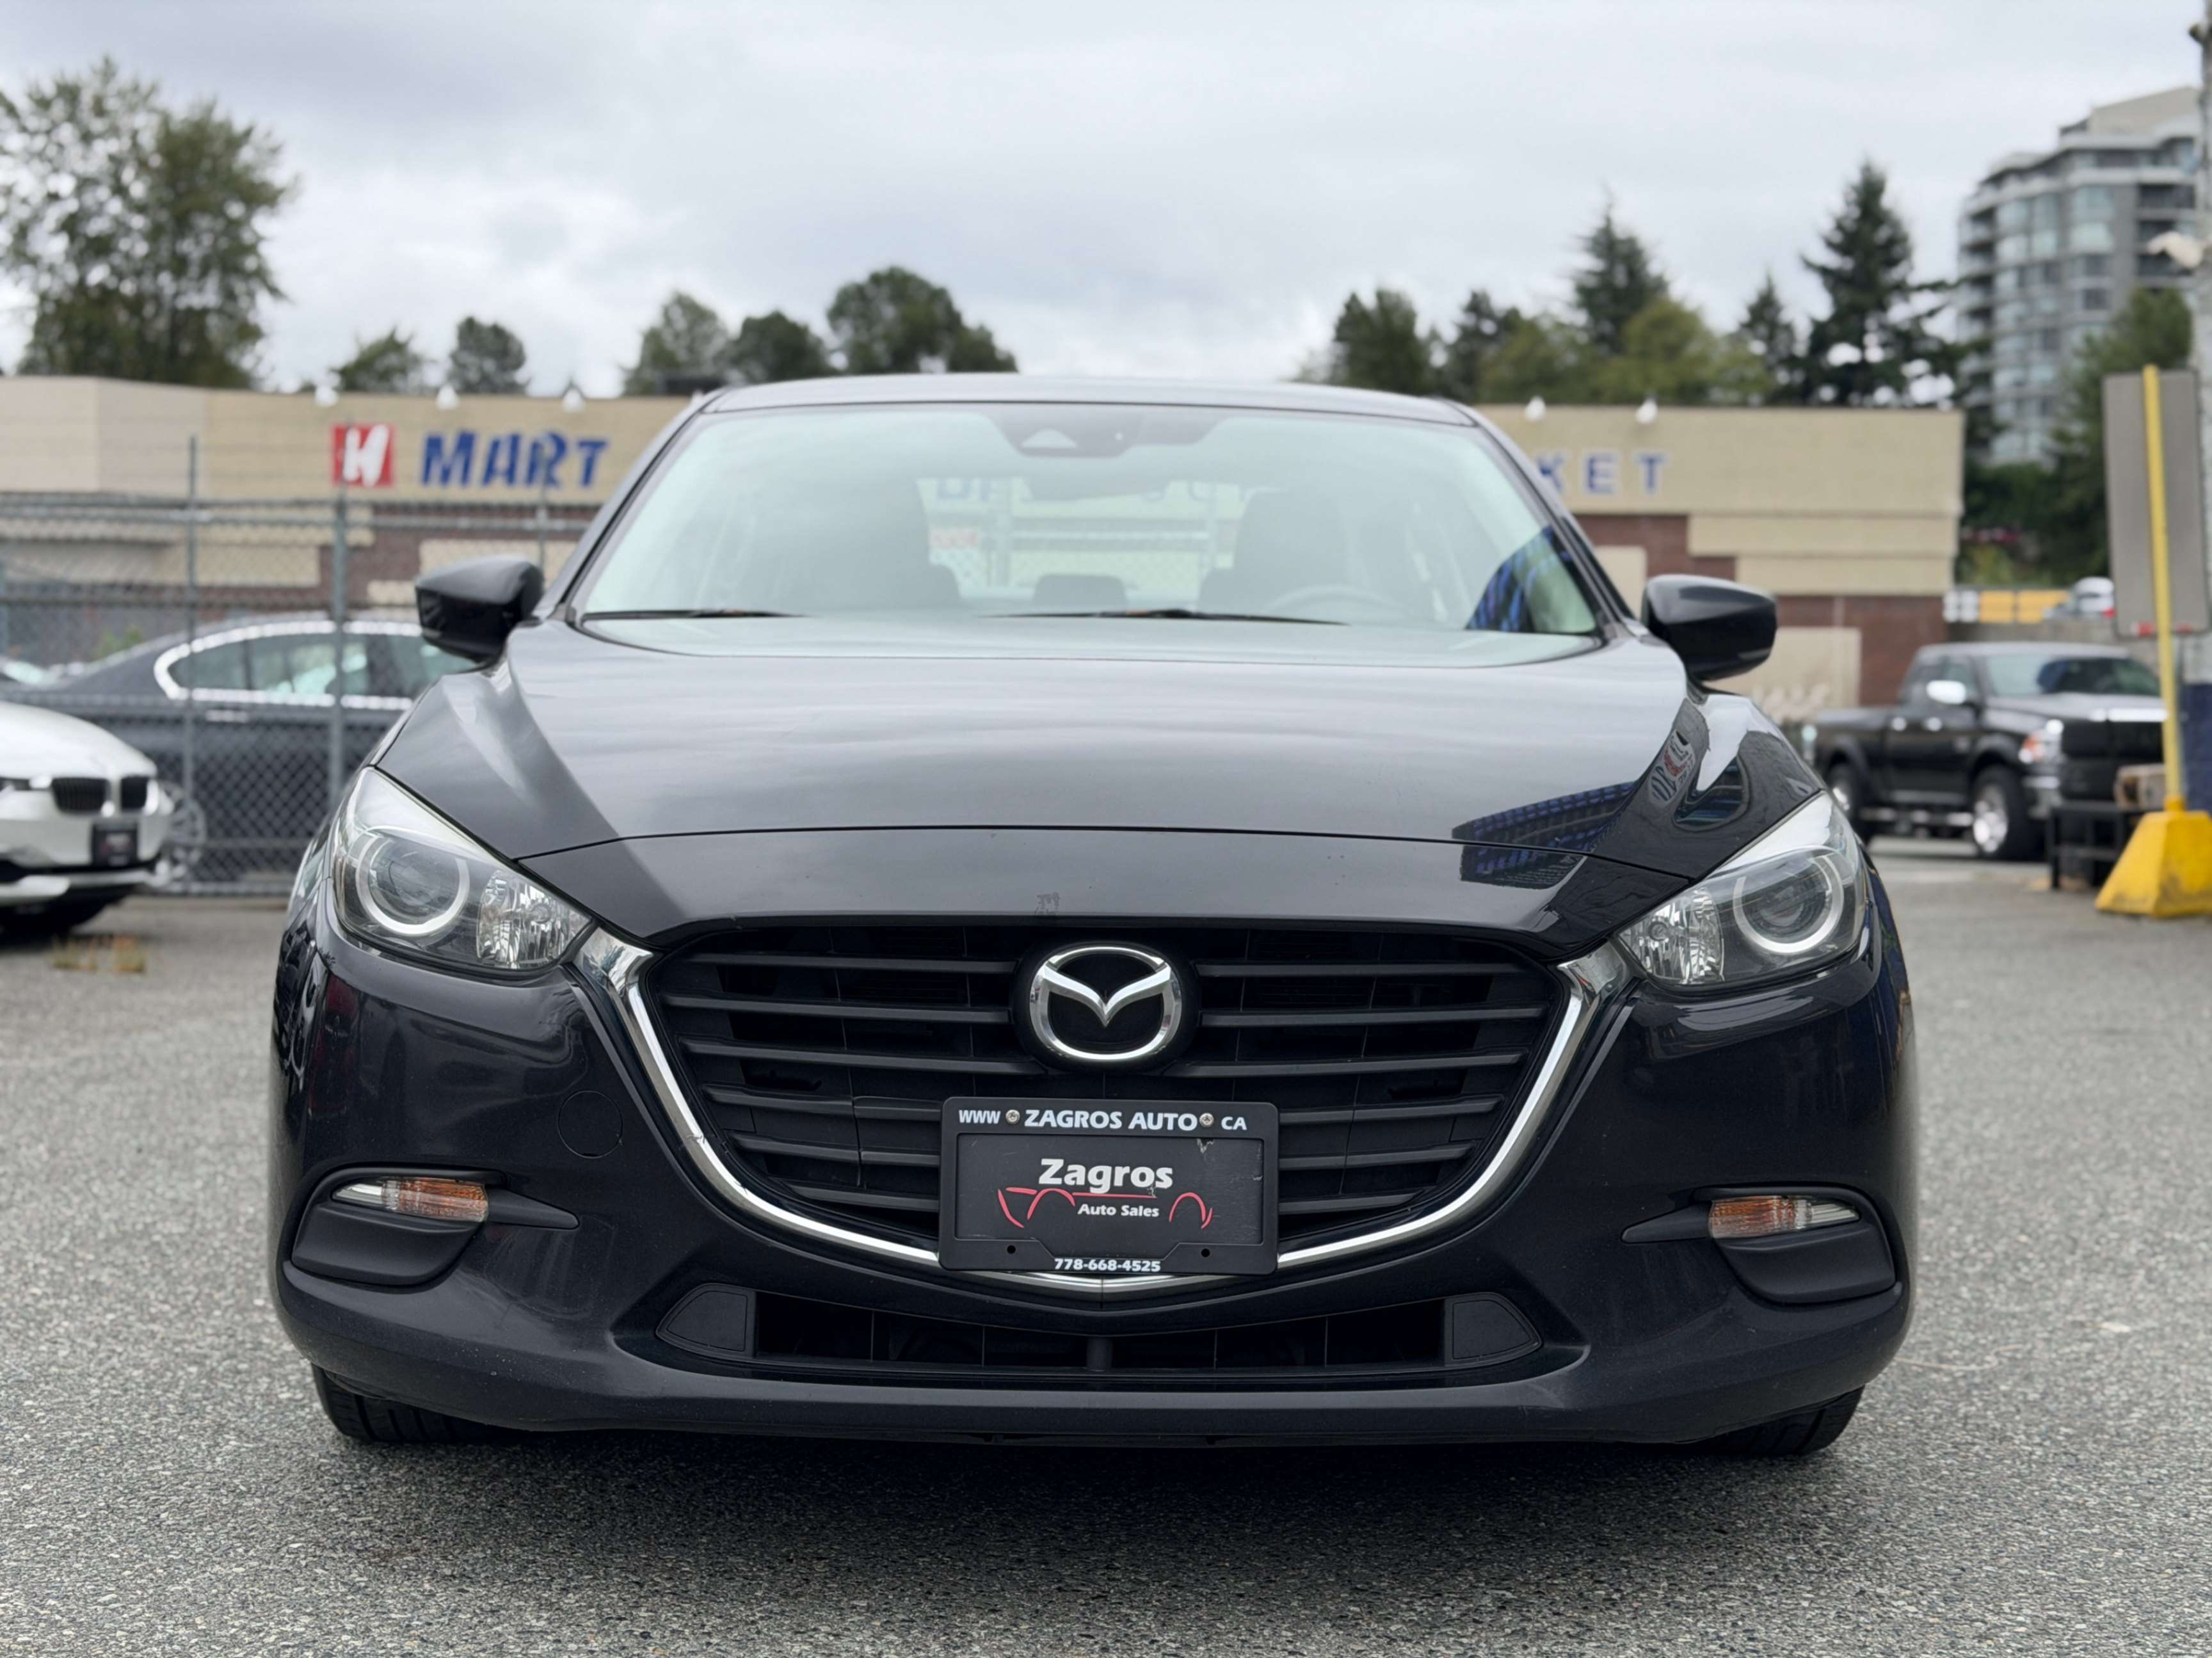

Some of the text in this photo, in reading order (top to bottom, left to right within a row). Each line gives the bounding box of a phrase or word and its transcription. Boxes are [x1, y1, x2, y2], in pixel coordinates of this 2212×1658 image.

[342, 424, 611, 488] H MART
[958, 1109, 1248, 1132] WWW ZAGROS AUTO CA
[1038, 1158, 1174, 1194] Zagros
[1077, 1203, 1160, 1218] Auto Sales
[1054, 1257, 1162, 1273] 778-668-4525
